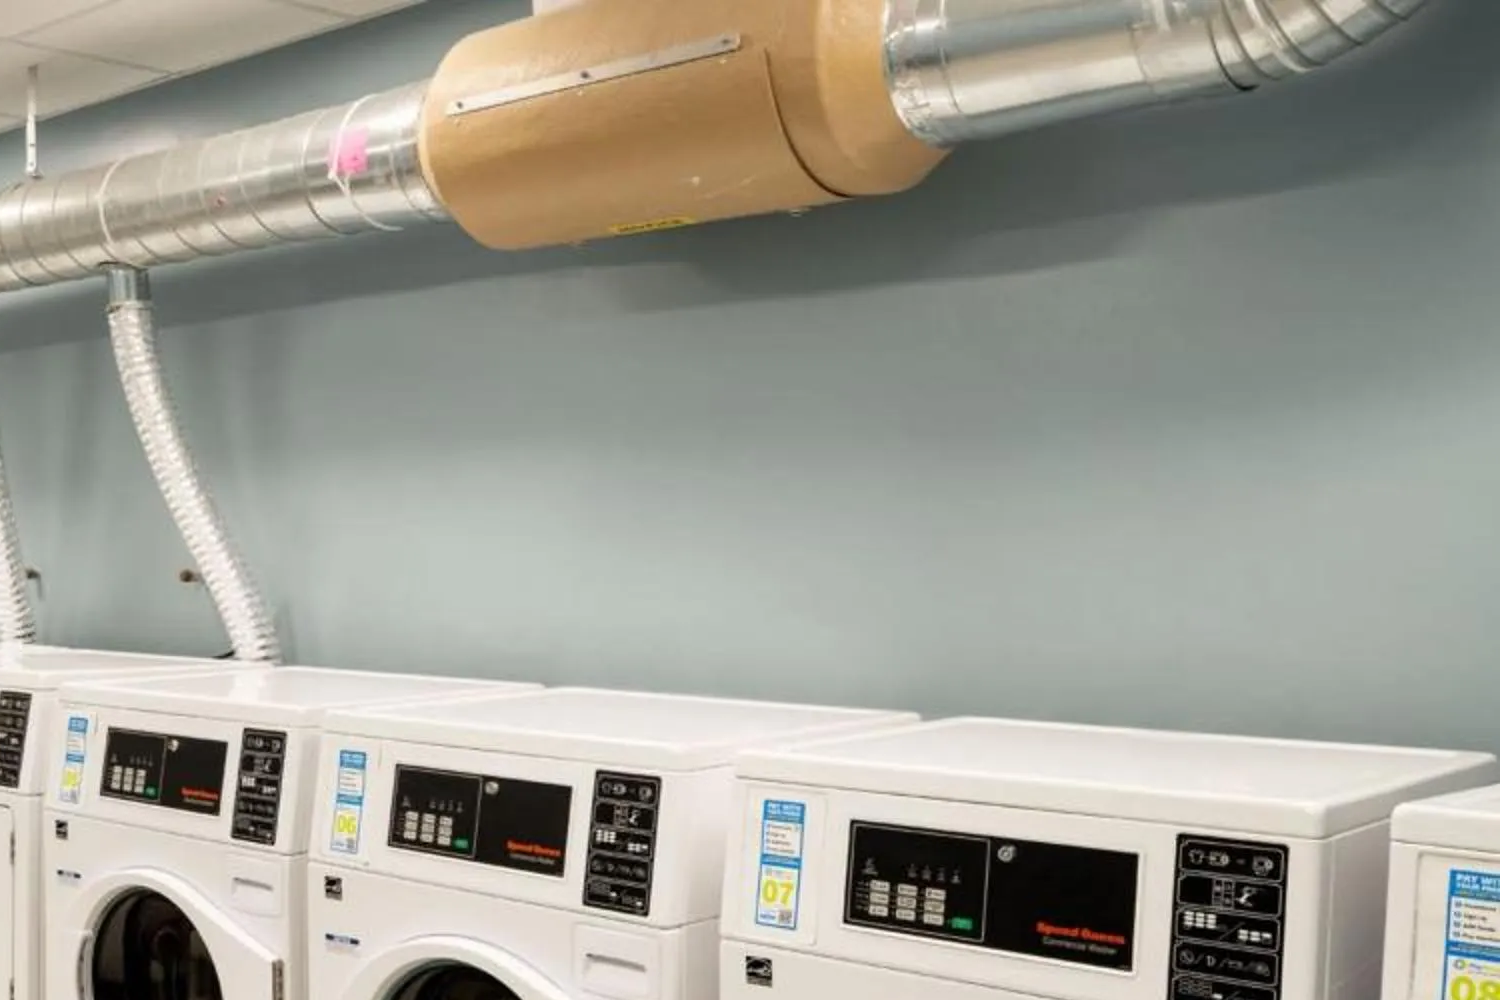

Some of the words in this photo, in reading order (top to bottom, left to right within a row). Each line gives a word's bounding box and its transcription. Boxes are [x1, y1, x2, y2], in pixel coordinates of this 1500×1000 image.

[762, 878, 795, 906] 07
[1036, 920, 1079, 937] Speed
[1081, 927, 1126, 945] Queen
